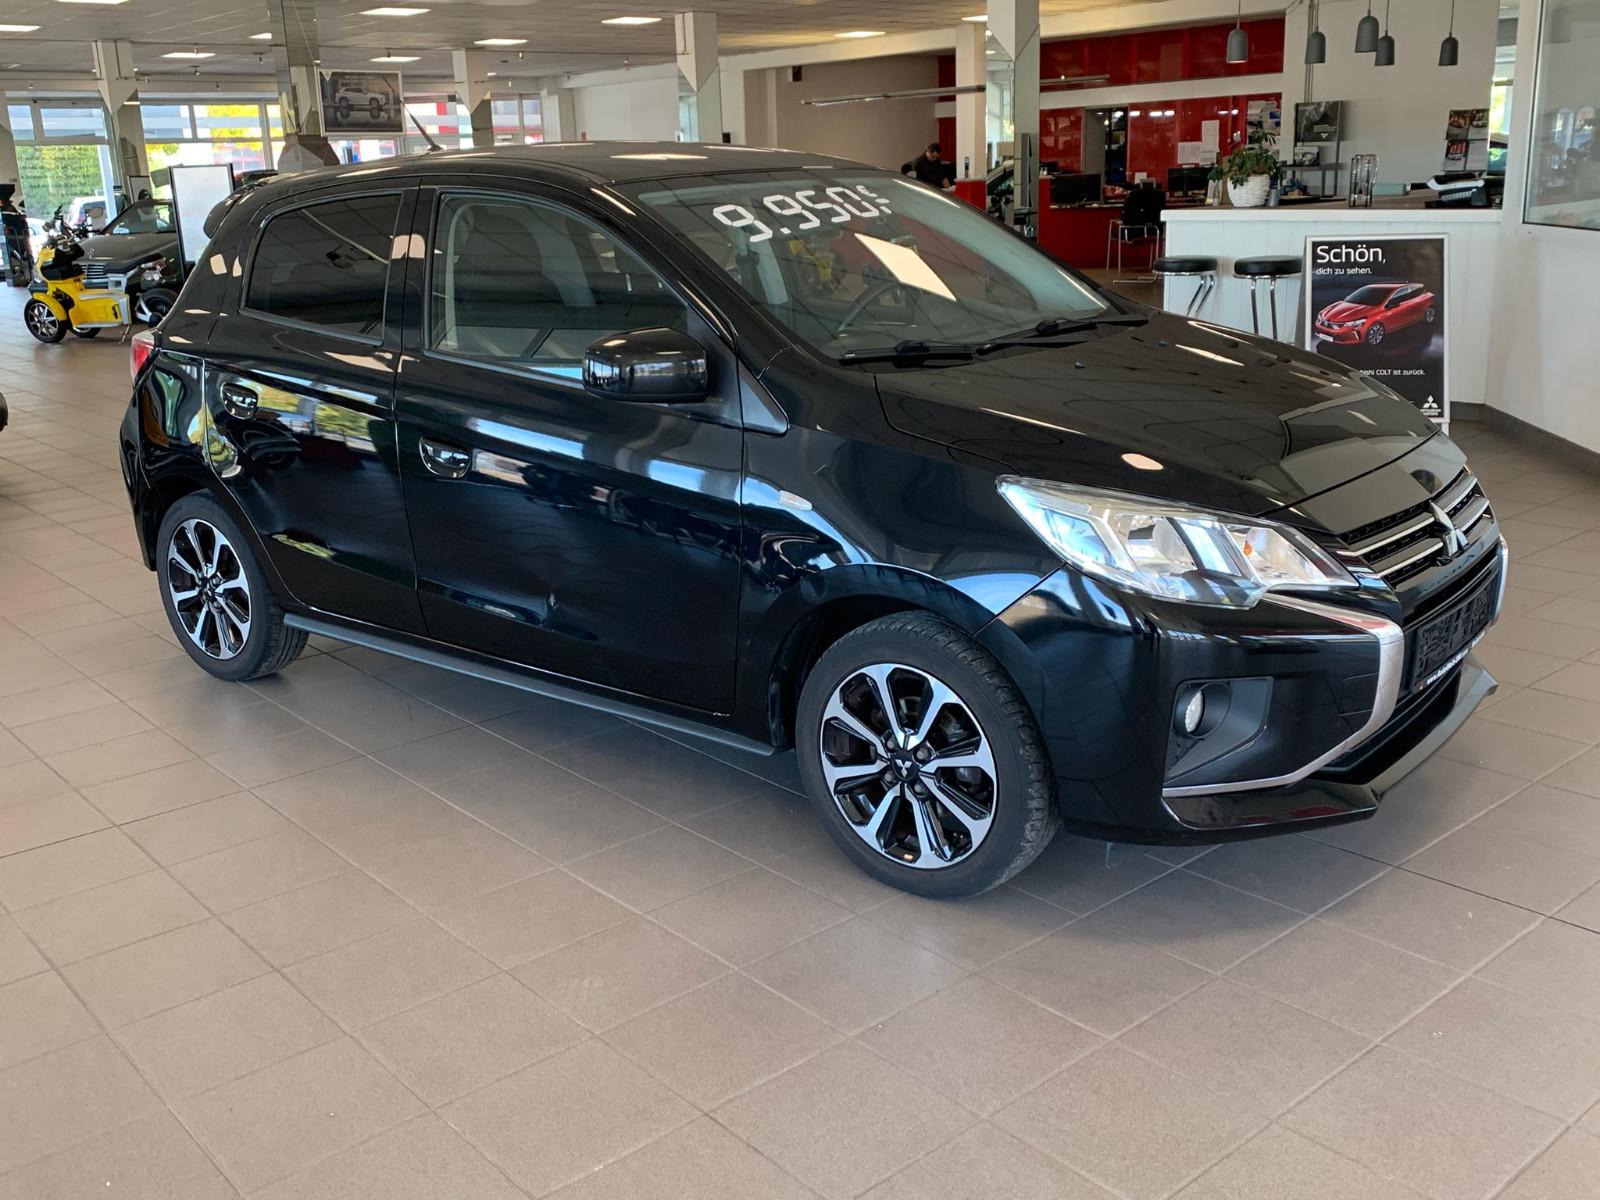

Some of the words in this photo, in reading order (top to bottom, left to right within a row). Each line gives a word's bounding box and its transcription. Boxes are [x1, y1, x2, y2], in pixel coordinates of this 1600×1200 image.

[1316, 244, 1386, 264] Schön,
[1315, 267, 1333, 275] dich
[1346, 266, 1372, 275] sehen.
